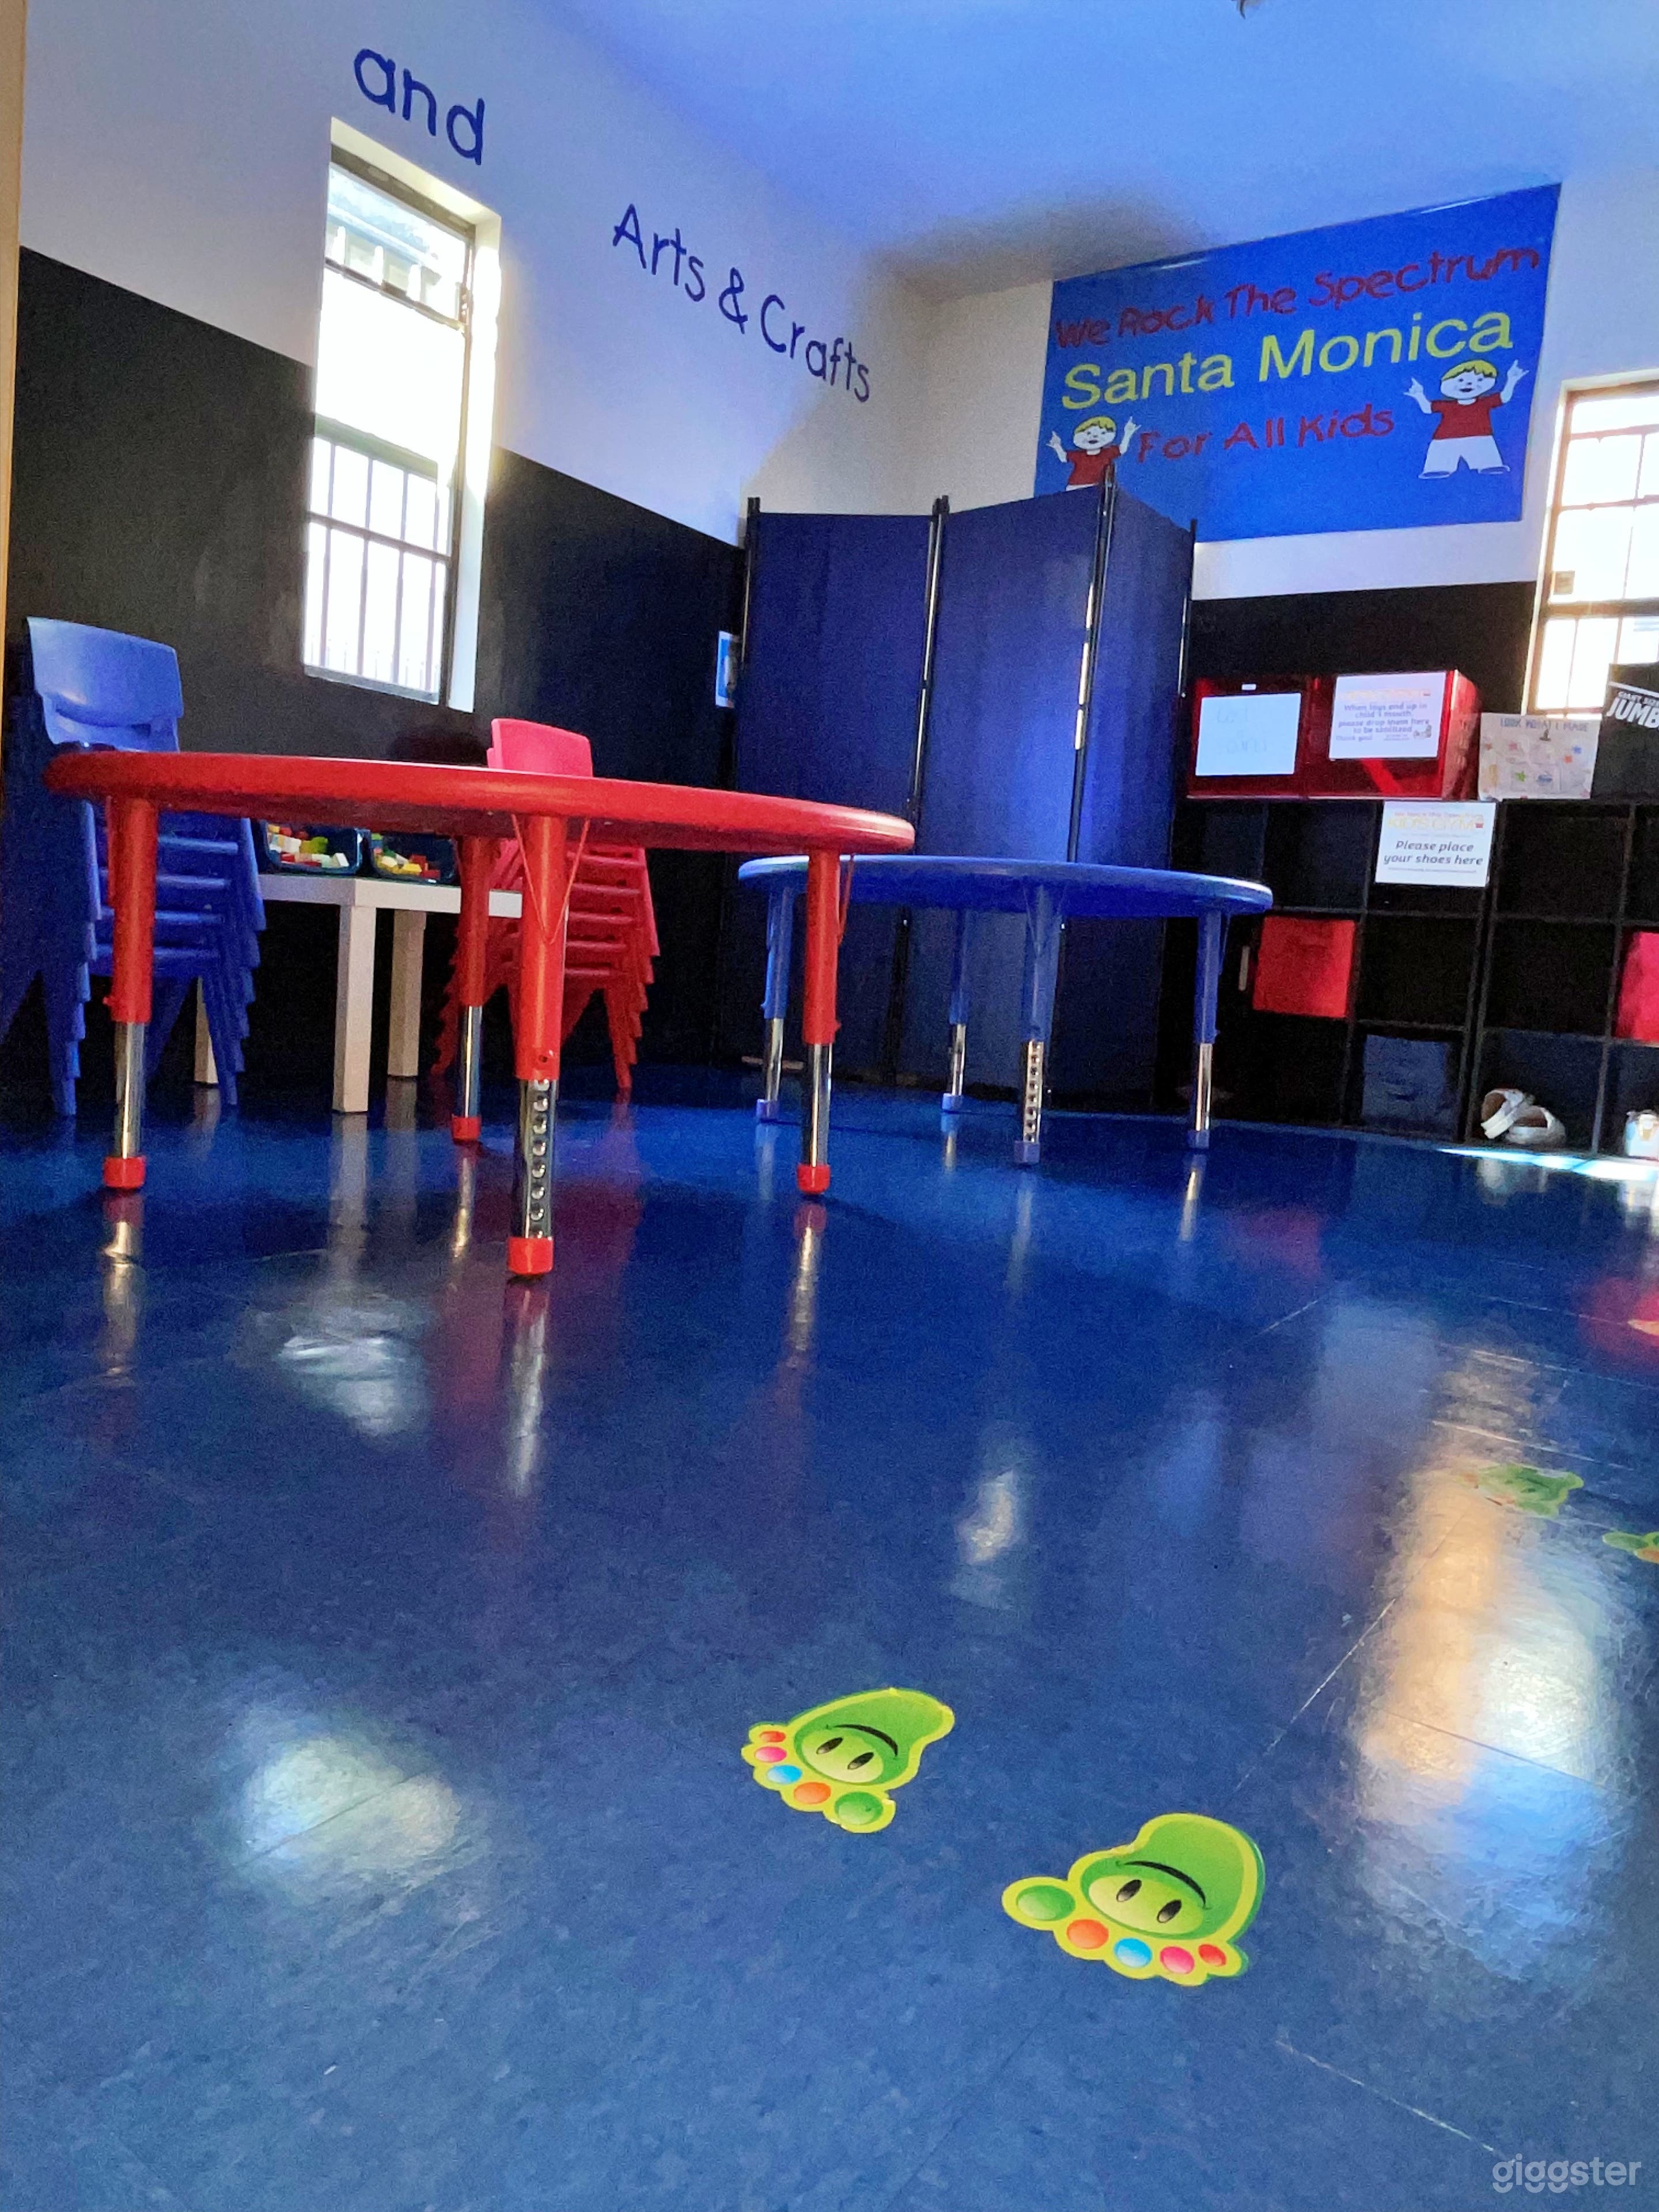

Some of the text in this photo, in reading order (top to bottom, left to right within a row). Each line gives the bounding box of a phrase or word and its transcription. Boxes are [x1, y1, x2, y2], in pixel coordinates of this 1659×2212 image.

[353, 48, 486, 166] and
[612, 203, 870, 403] Arts & Crafts
[1055, 247, 1540, 348] We Rock The Spectrum
[1062, 312, 1513, 410] Santa Monica
[1138, 403, 1395, 463] For All Kids
[1606, 696, 1659, 730] JUMB
[1383, 854, 1484, 866] your shoes here
[1396, 840, 1474, 853] Please place
